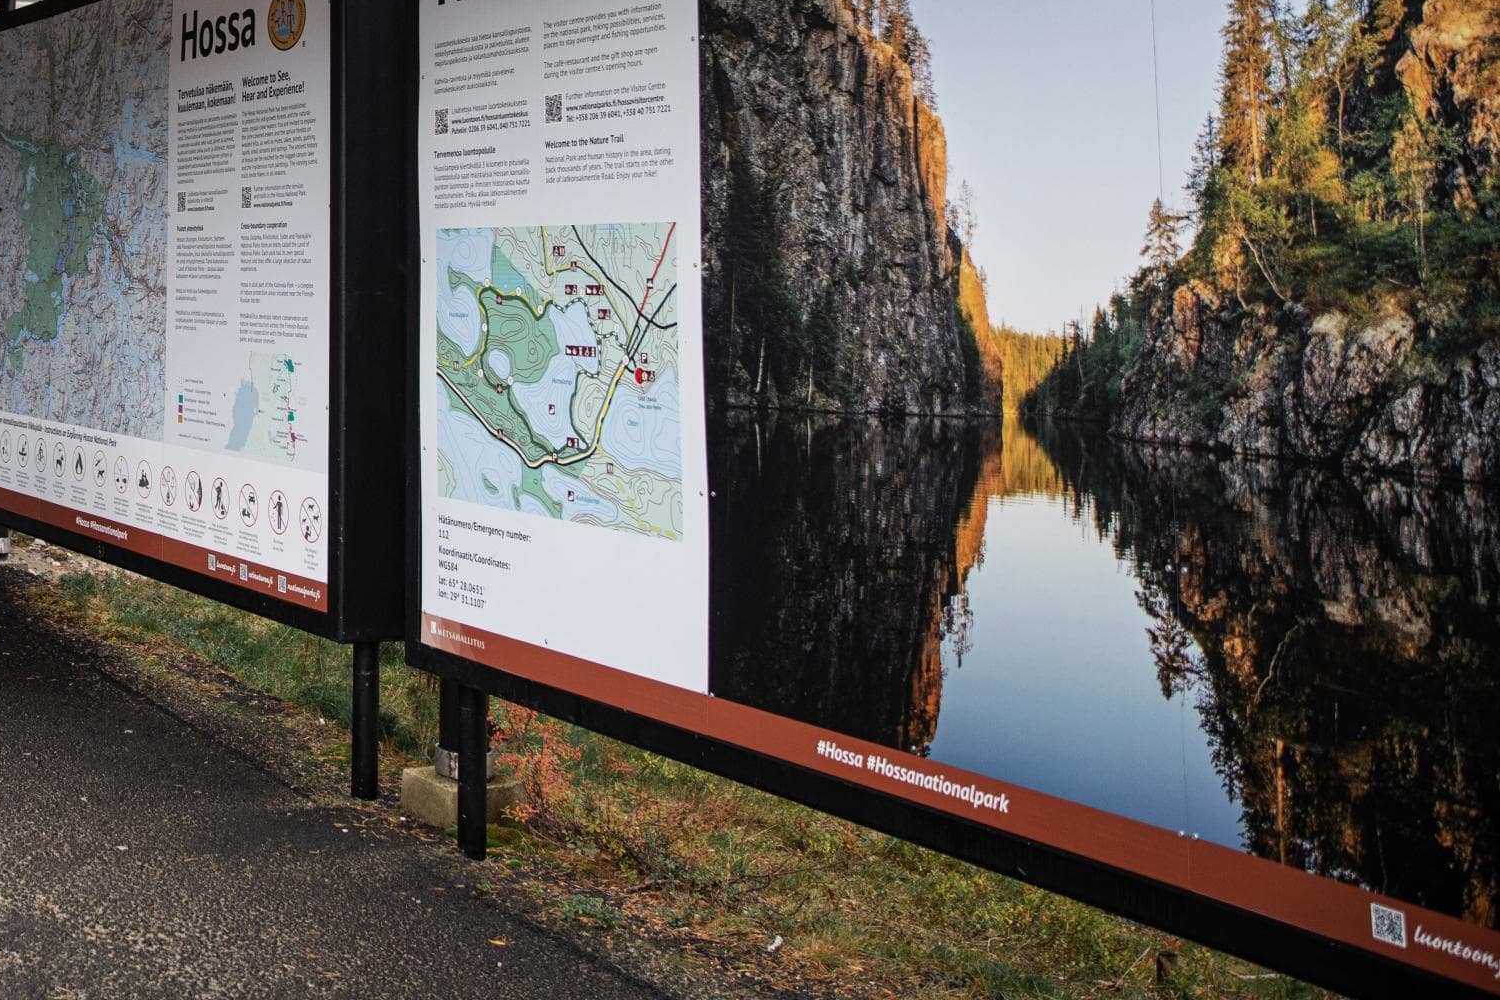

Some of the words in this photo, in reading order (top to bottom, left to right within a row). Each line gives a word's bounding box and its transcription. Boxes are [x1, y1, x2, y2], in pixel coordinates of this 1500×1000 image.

[180, 8, 256, 62] Hossa
[242, 74, 268, 88] Welcome
[270, 73, 276, 83] to
[278, 70, 291, 82] See,
[242, 91, 255, 103] Hear
[257, 88, 267, 99] and
[269, 81, 305, 100] Experience!
[545, 139, 569, 149] Welcome
[572, 138, 577, 146] to
[579, 137, 588, 146] the
[590, 135, 608, 145] Nature
[611, 134, 624, 143] Trail
[438, 515, 505, 539] Hätänumero/Emergency
[506, 530, 532, 543] number:
[438, 529, 449, 539] 112
[438, 545, 511, 570] Koordinaatit/Coordinates:
[438, 559, 458, 571] WGS84
[816, 740, 864, 768] #Hossa
[866, 755, 1010, 813] #Hossanationalpark
